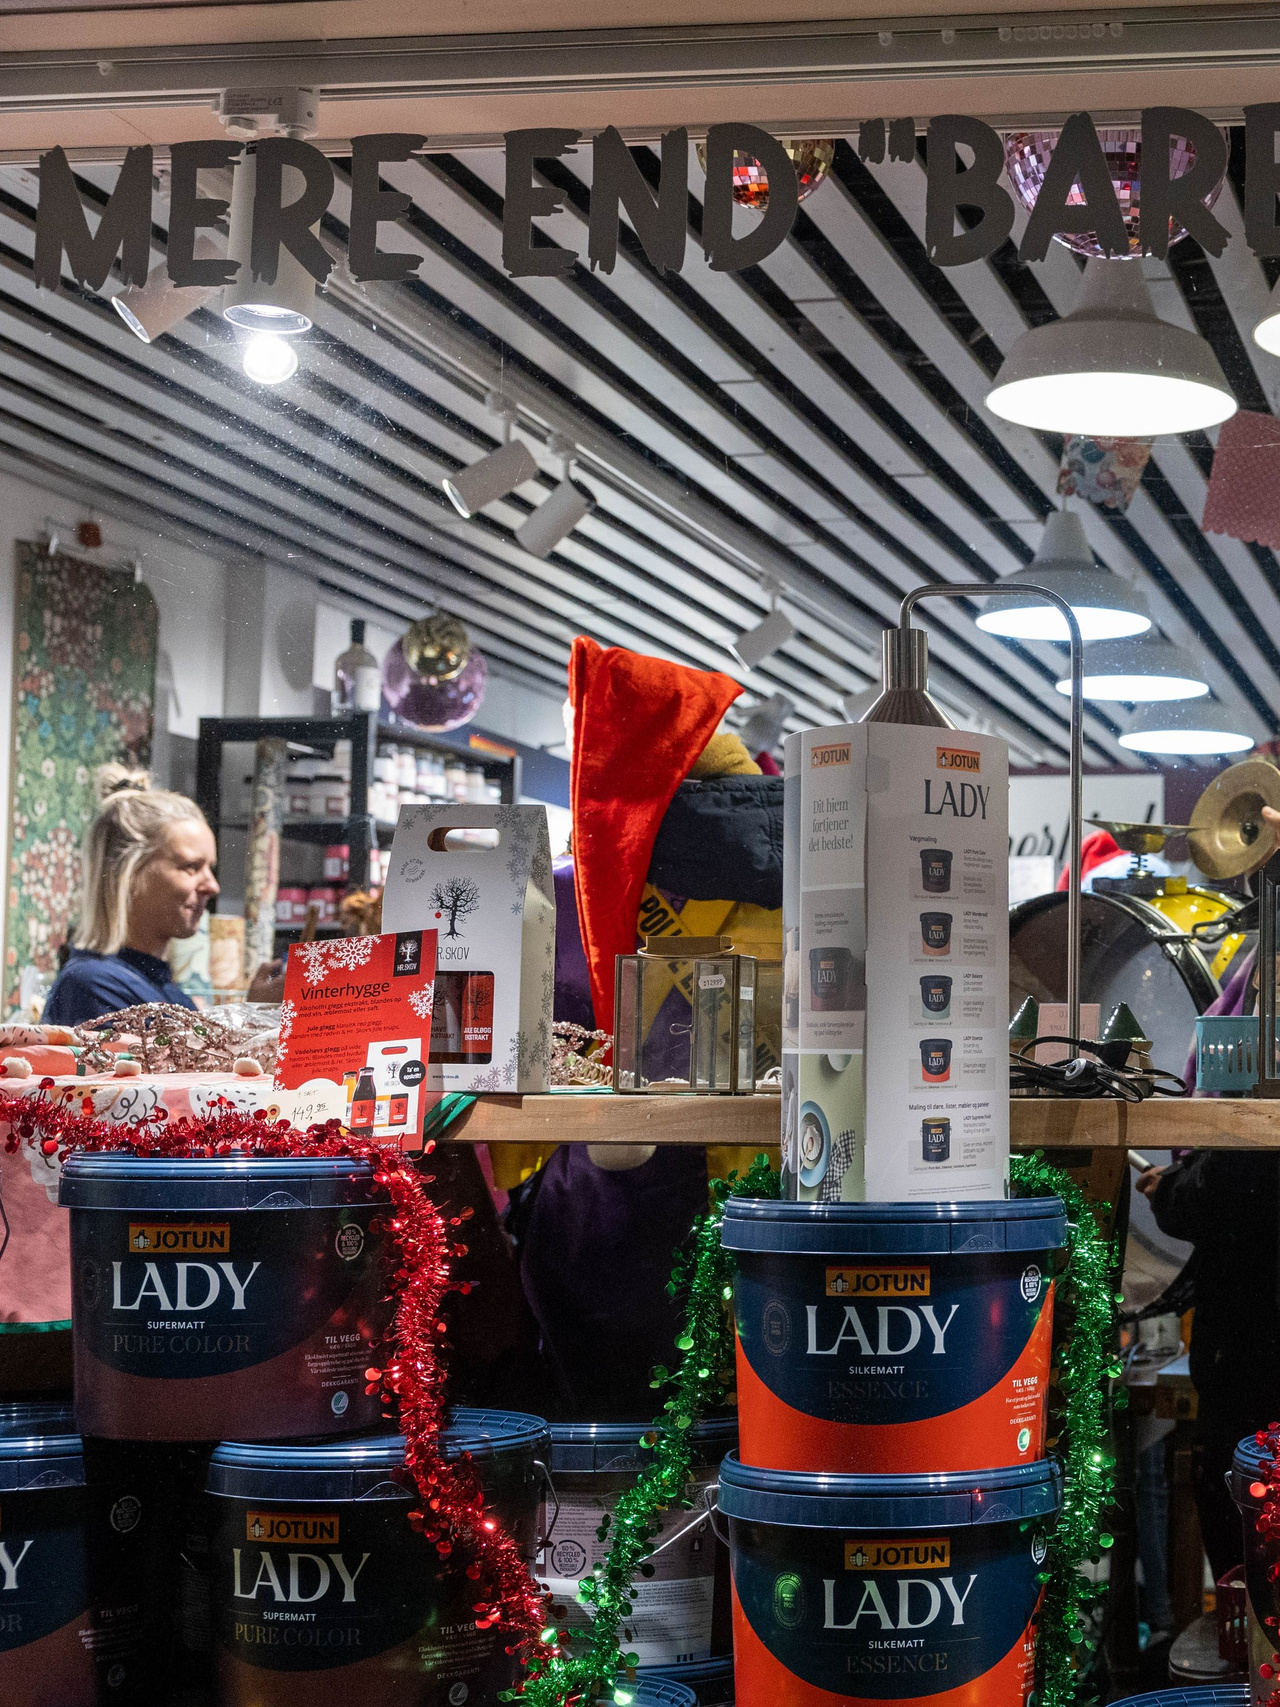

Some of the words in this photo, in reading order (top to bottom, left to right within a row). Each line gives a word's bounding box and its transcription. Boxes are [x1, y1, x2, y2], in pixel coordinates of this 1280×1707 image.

[33, 133, 428, 291] MERE
[502, 122, 800, 279] END
[820, 748, 850, 765] JOTUN
[949, 754, 980, 770] JOTUN
[813, 799, 825, 814] Dit
[826, 797, 849, 816] hjem
[924, 779, 991, 820] LADY
[812, 816, 850, 835] fortjener
[809, 837, 821, 853] det
[822, 834, 854, 852] bedste!
[928, 867, 945, 877] LADY
[928, 930, 945, 940] LADY
[437, 946, 470, 961] R.SKOV
[396, 962, 418, 973] HR.SKOV
[817, 969, 838, 984] LADY
[301, 981, 390, 1002] Vinterhygge
[928, 994, 945, 1003] LADY
[431, 1032, 455, 1040] KSTRAKT
[928, 1057, 945, 1066] LADY
[909, 1103, 926, 1112] Maling
[932, 1103, 945, 1111] døre,
[928, 1134, 945, 1143] LADY
[153, 1229, 225, 1250] JOTUN
[110, 1260, 262, 1311] LADY
[852, 1273, 926, 1292] JOTUN
[146, 1320, 206, 1330] SUPERMATT
[805, 1304, 961, 1356] LADY
[112, 1333, 163, 1353] PURE
[169, 1334, 250, 1354] COLOR
[324, 1335, 338, 1345] TIL
[340, 1333, 361, 1344] VEGG
[848, 1365, 905, 1375] SILKEMATT
[828, 1379, 929, 1400] ESSENCE
[1012, 1379, 1022, 1387] TIL
[1023, 1375, 1038, 1386] VEGG
[267, 1519, 335, 1540] JOTUN
[872, 1545, 947, 1566] JOTUN
[232, 1547, 372, 1603] LADY
[822, 1573, 979, 1631] LADY
[262, 1611, 318, 1622] SUPERMATT
[234, 1621, 280, 1645] PURE
[281, 1627, 362, 1648] COLOR
[440, 1625, 455, 1636] TIL
[457, 1622, 478, 1634] VEG
[868, 1638, 925, 1650] SILKEMATT
[847, 1652, 949, 1675] ESSENCE
